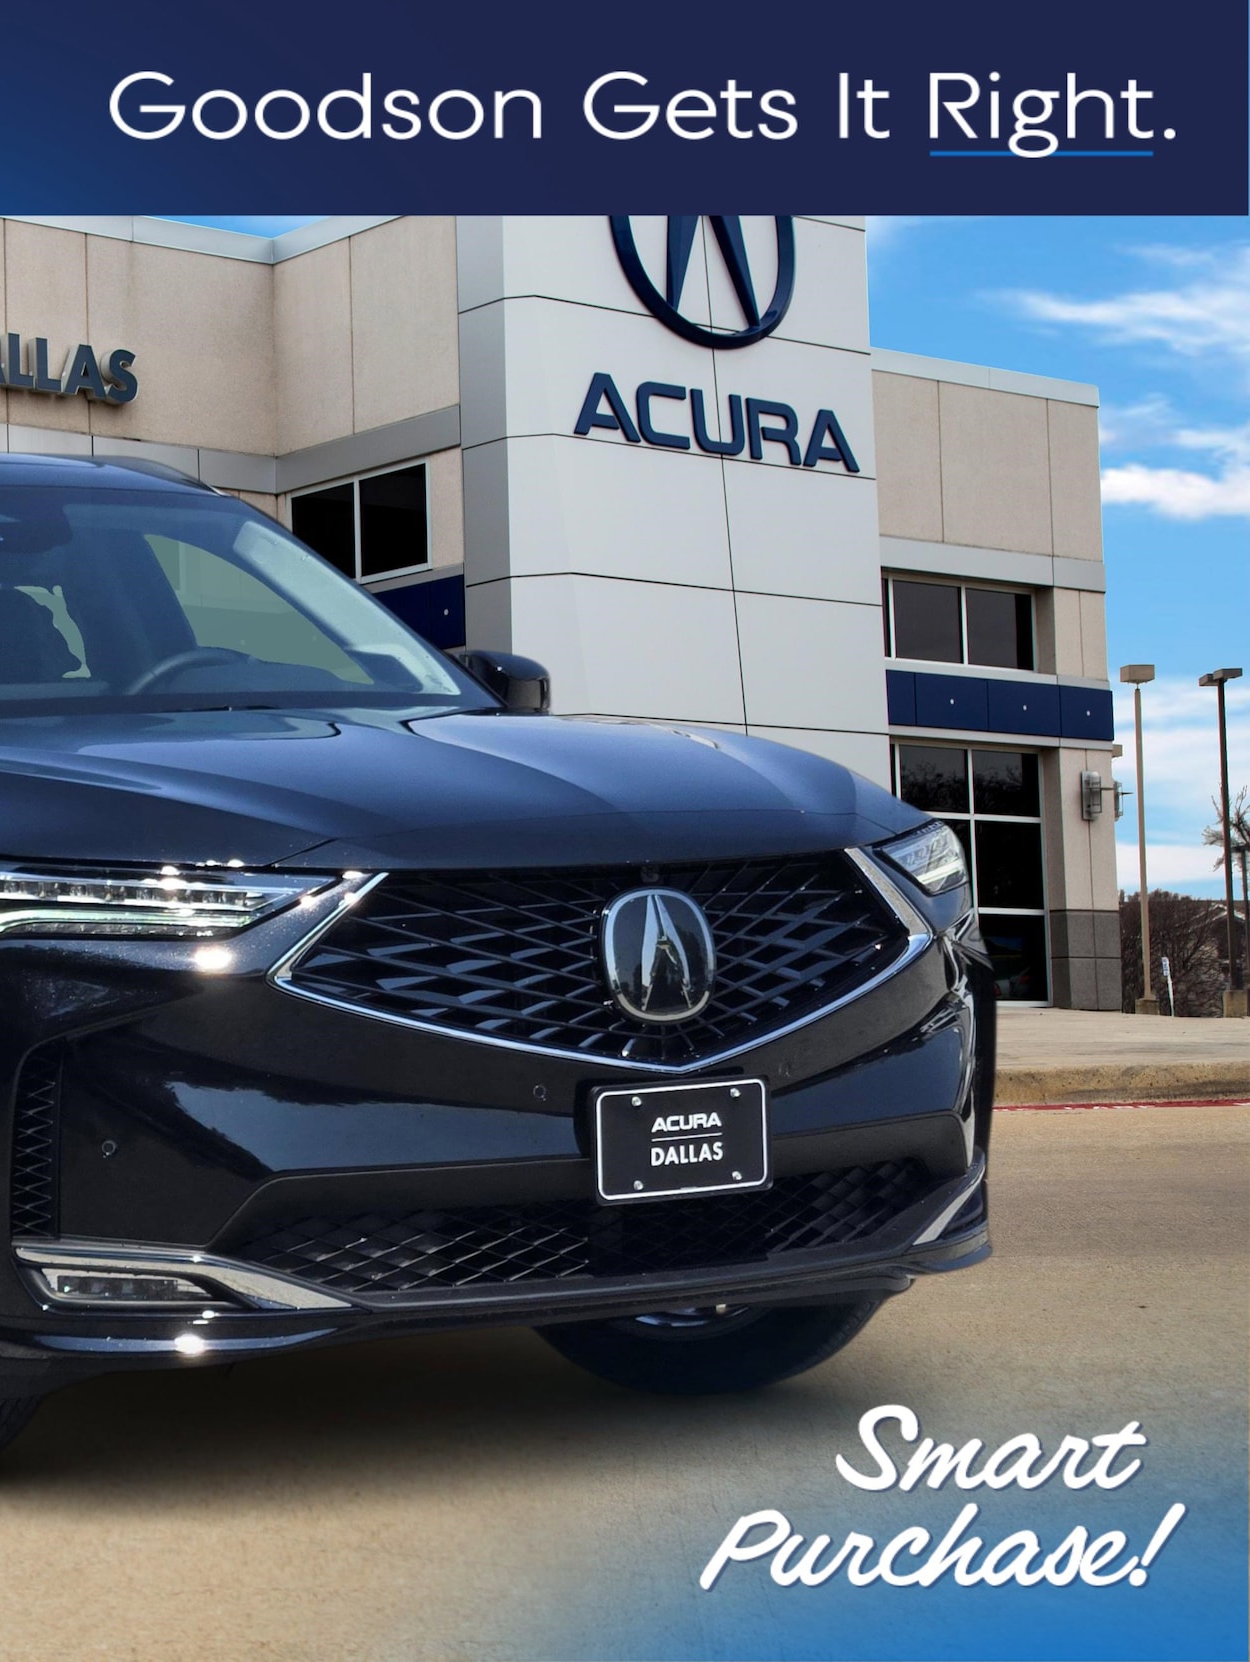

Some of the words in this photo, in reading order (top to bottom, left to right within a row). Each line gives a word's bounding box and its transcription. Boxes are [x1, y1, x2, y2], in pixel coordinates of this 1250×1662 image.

[573, 372, 860, 473] ACURA
[651, 1111, 723, 1133] ACURA
[650, 1141, 724, 1167] DALLAS
